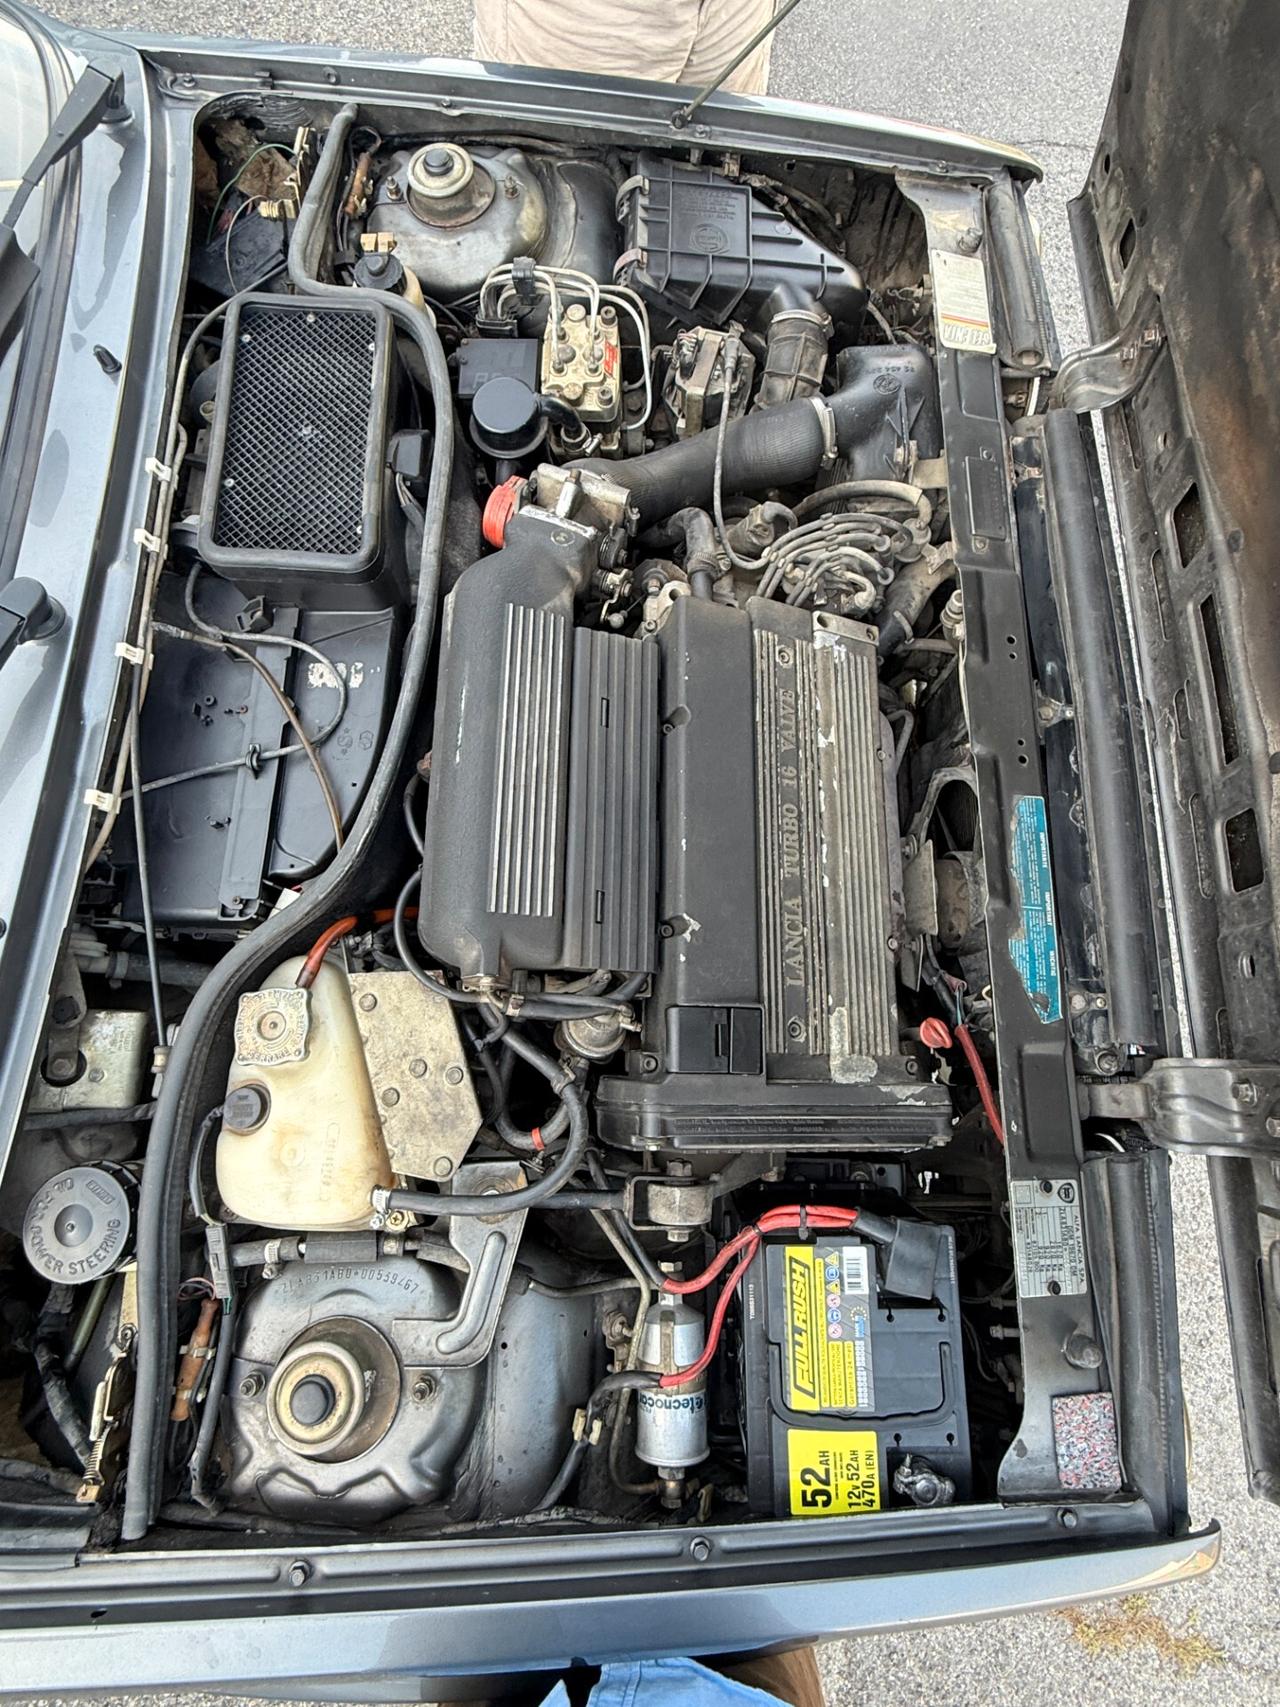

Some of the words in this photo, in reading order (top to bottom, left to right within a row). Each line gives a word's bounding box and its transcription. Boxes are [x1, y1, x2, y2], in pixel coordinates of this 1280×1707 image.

[778, 688, 797, 752] VALVE
[781, 766, 799, 788] 16
[781, 803, 800, 877] TURBO
[1045, 892, 1053, 925] IMPORTANT
[782, 896, 804, 987] LANCIA
[31, 1224, 64, 1273] POWER
[68, 1218, 121, 1275] STEERING
[791, 1261, 808, 1329] RUSH
[793, 1331, 814, 1393] FULL
[865, 1450, 874, 1470] (EN)
